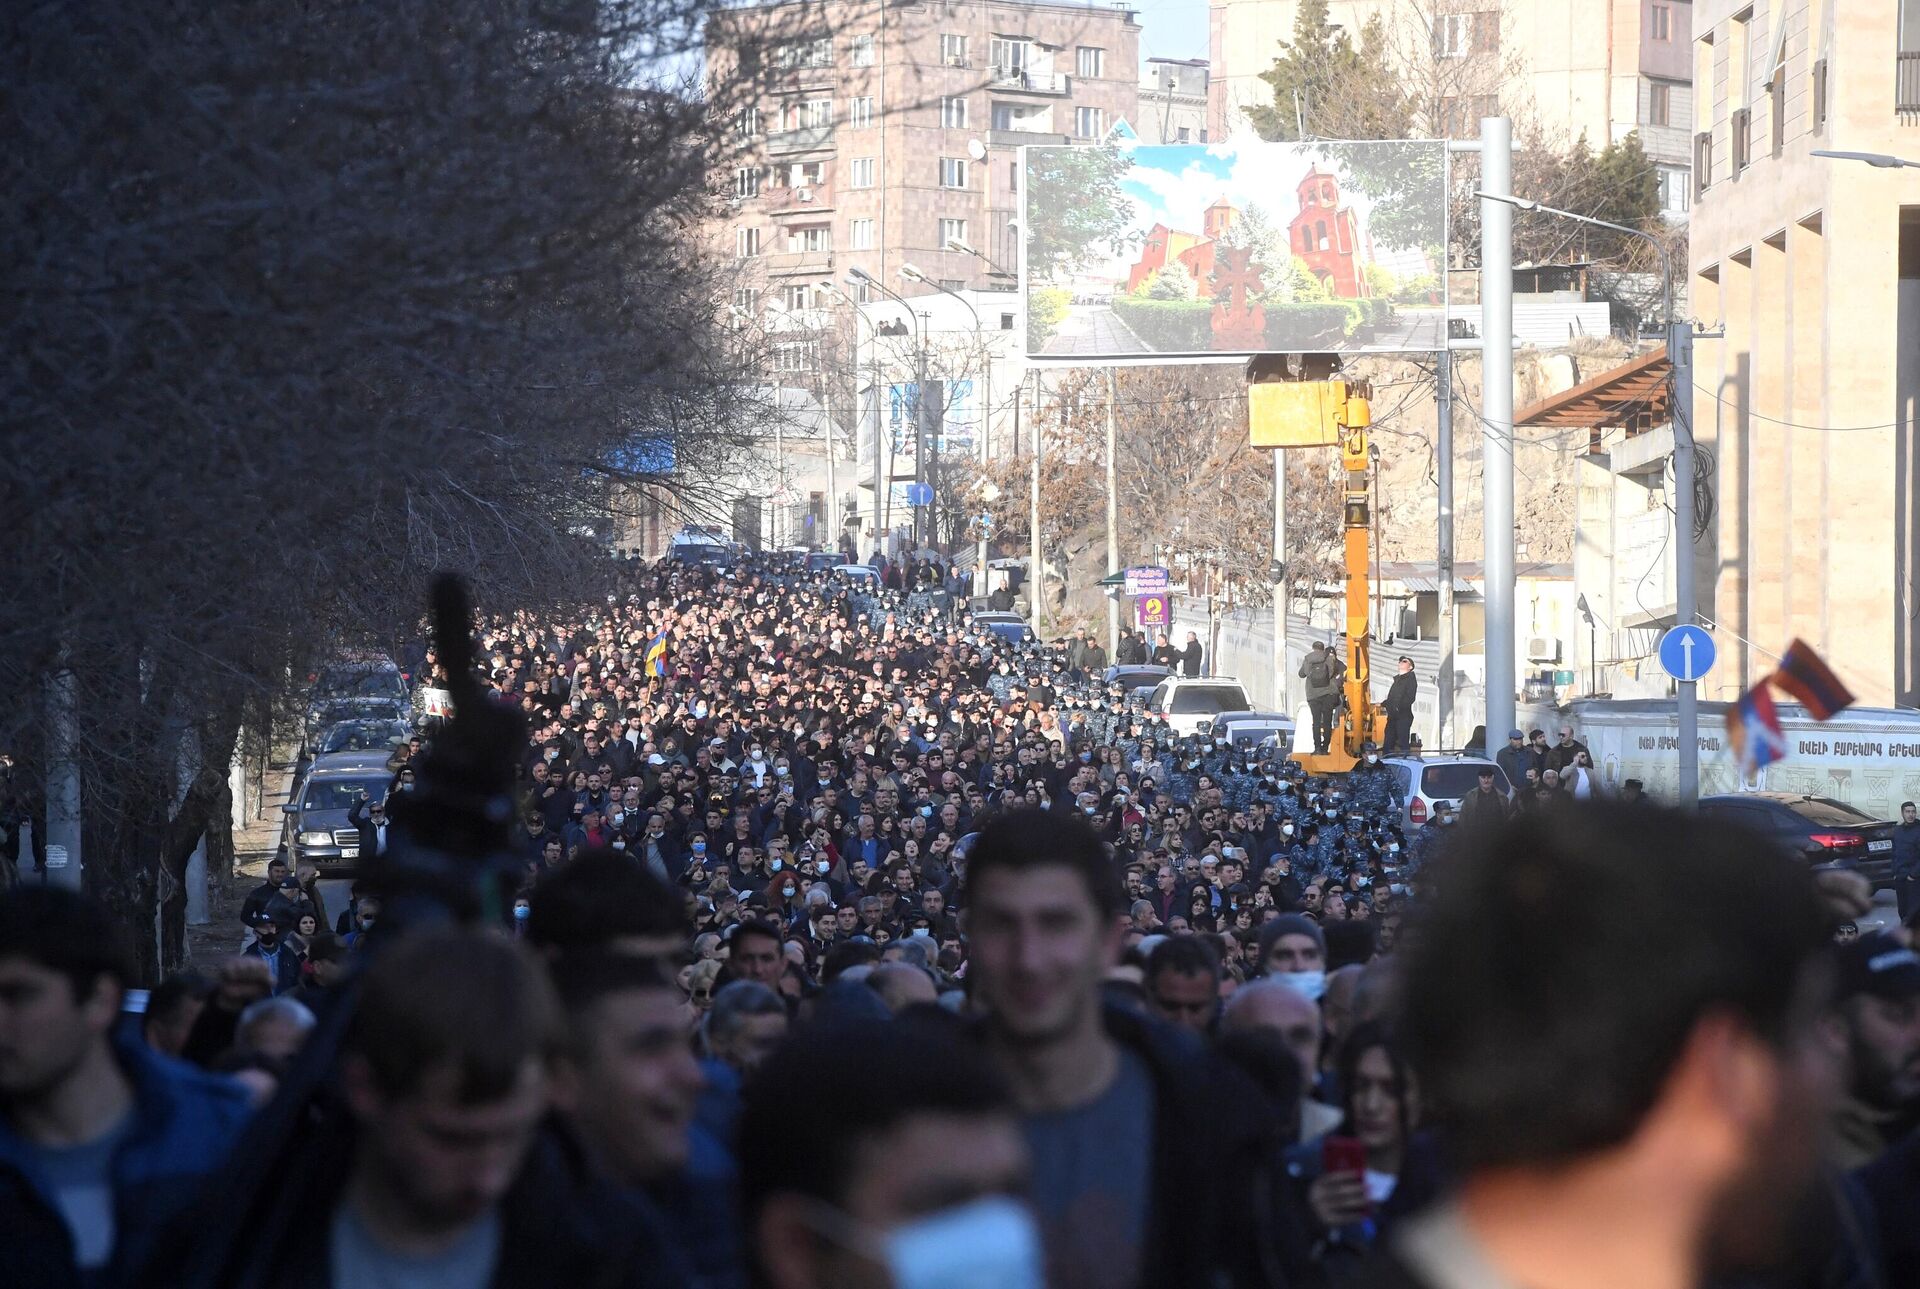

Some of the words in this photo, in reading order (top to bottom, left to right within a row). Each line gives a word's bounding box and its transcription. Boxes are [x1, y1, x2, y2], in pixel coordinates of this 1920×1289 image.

[1144, 614, 1164, 622] NEST
[1798, 741, 1829, 756] ԱՎԵԼԻ
[1833, 741, 1883, 757] ԲԱՐԵԿԱՐԳ
